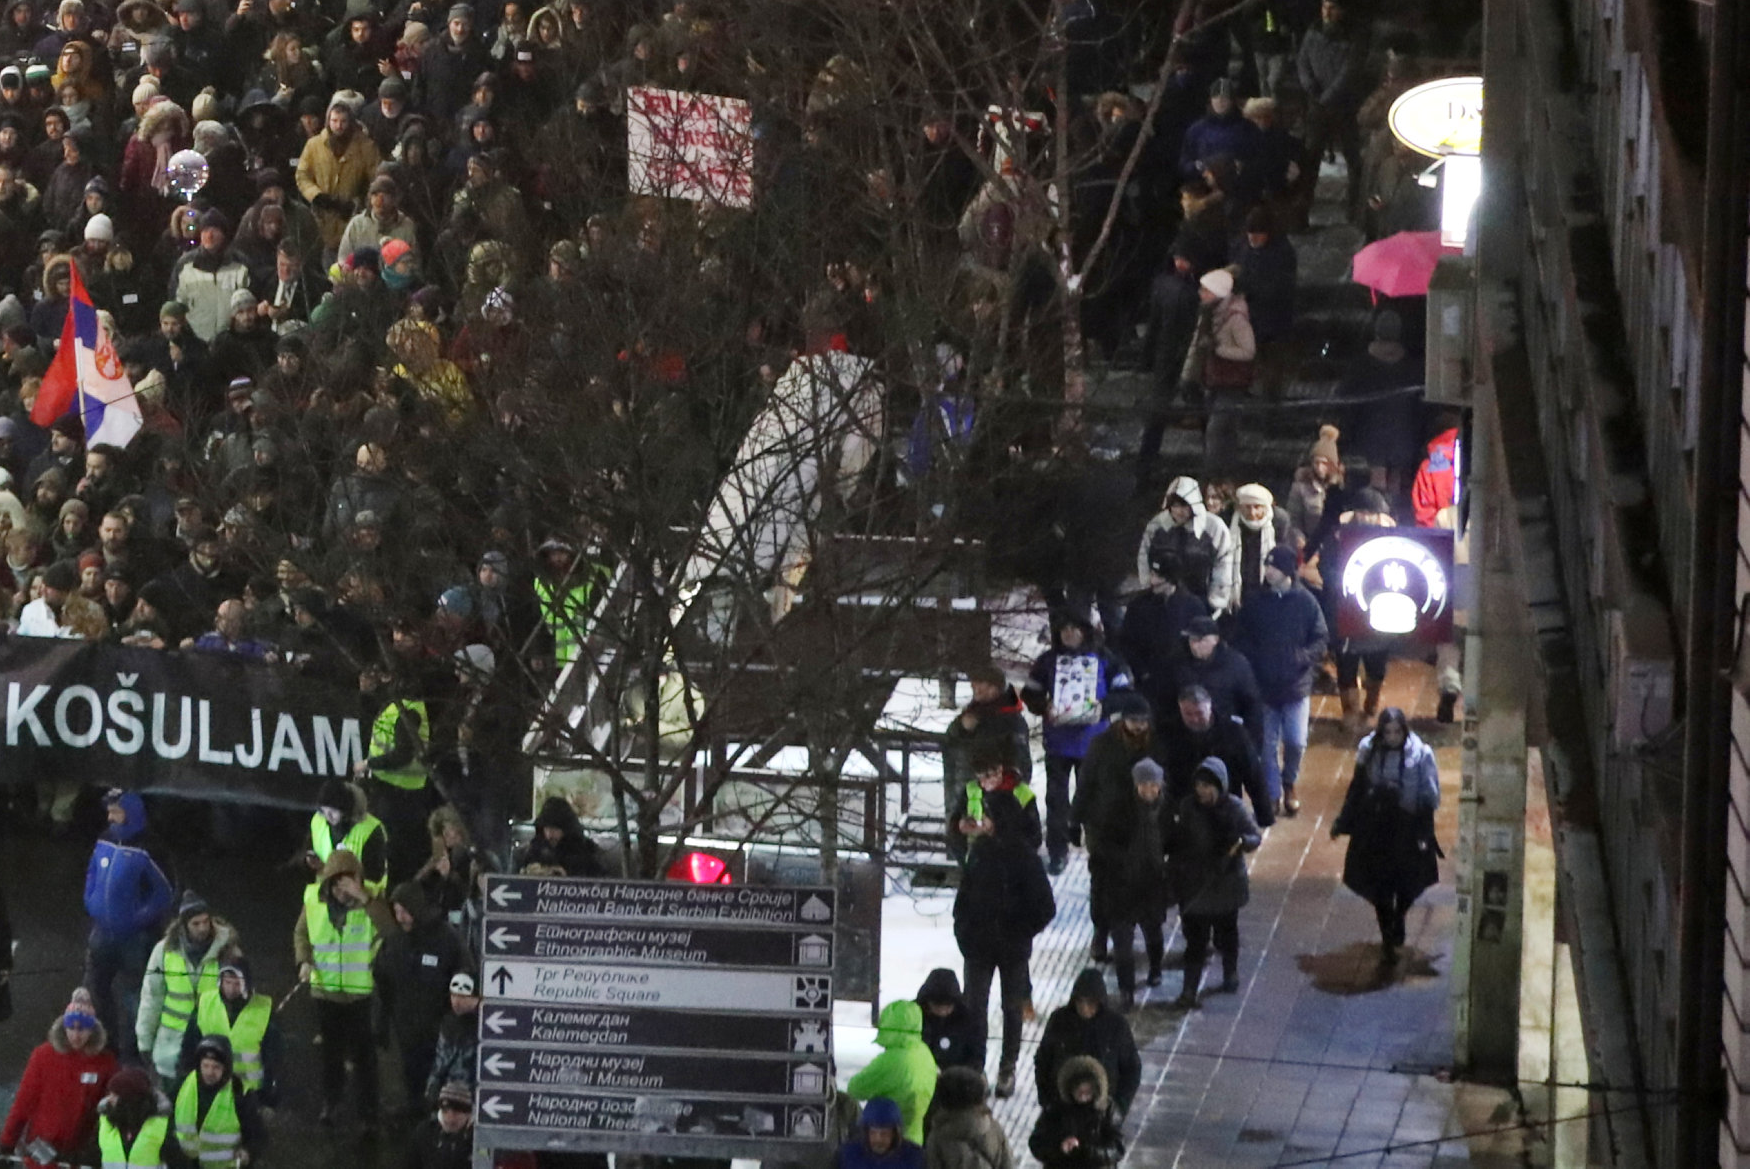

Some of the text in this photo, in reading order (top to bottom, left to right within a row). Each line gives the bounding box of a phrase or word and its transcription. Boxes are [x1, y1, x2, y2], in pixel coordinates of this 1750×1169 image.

[5, 672, 365, 778] KOŠULJAM
[536, 881, 610, 898] Изложба
[613, 885, 683, 902] Народне
[686, 889, 735, 903] банке
[536, 898, 793, 922] National Bank of Serbia Exhibition
[648, 930, 692, 947] музеј
[534, 941, 707, 961] Ethnographic Museum
[534, 967, 560, 983] Трг
[533, 984, 661, 1002] Republic Square
[531, 1009, 630, 1028] Калемегдан
[531, 1025, 628, 1044] Kalemegdan
[530, 1051, 645, 1073] Народни музеј
[597, 1071, 664, 1087] Museum
[528, 1094, 598, 1112] Народно
[527, 1111, 591, 1127] National
